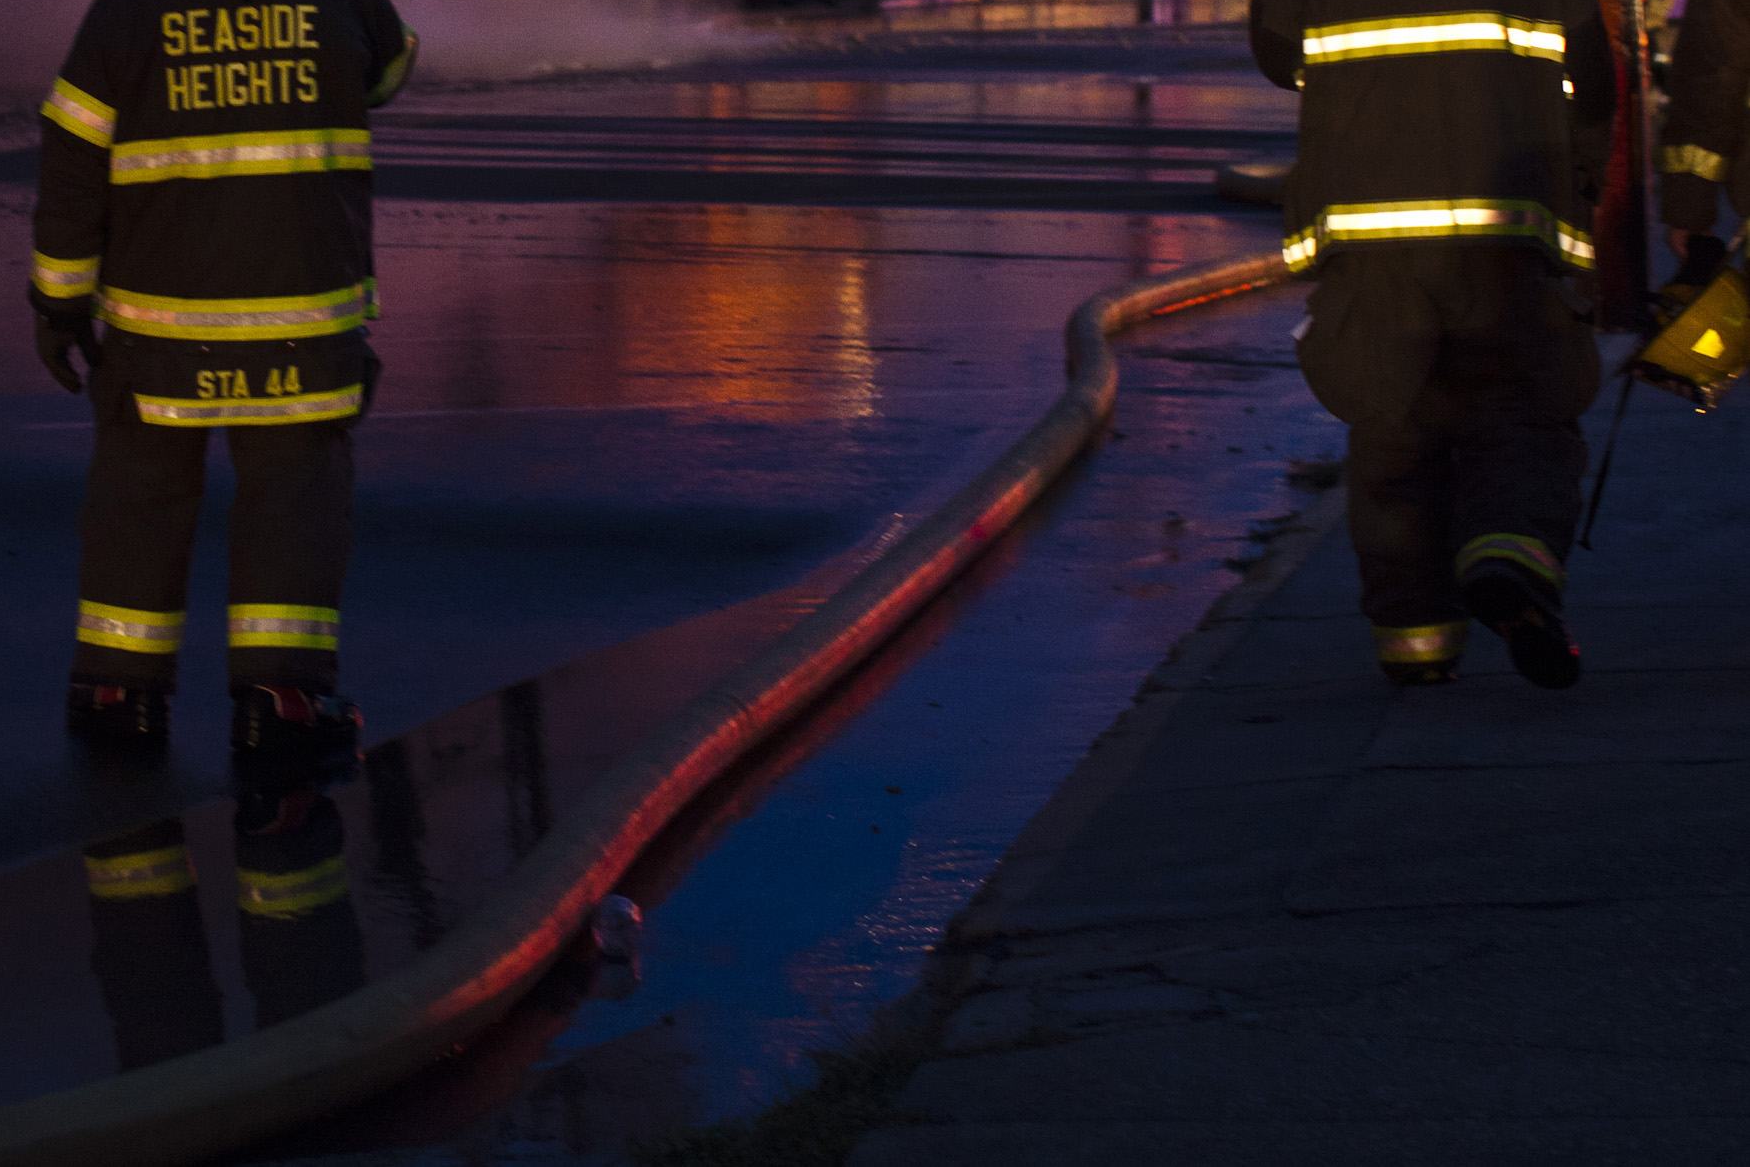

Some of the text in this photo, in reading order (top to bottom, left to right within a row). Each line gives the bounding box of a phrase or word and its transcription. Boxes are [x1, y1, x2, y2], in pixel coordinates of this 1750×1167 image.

[160, 4, 321, 57] SEASIDE
[165, 59, 320, 112] HEIGHTS
[196, 365, 302, 399] STA 44
